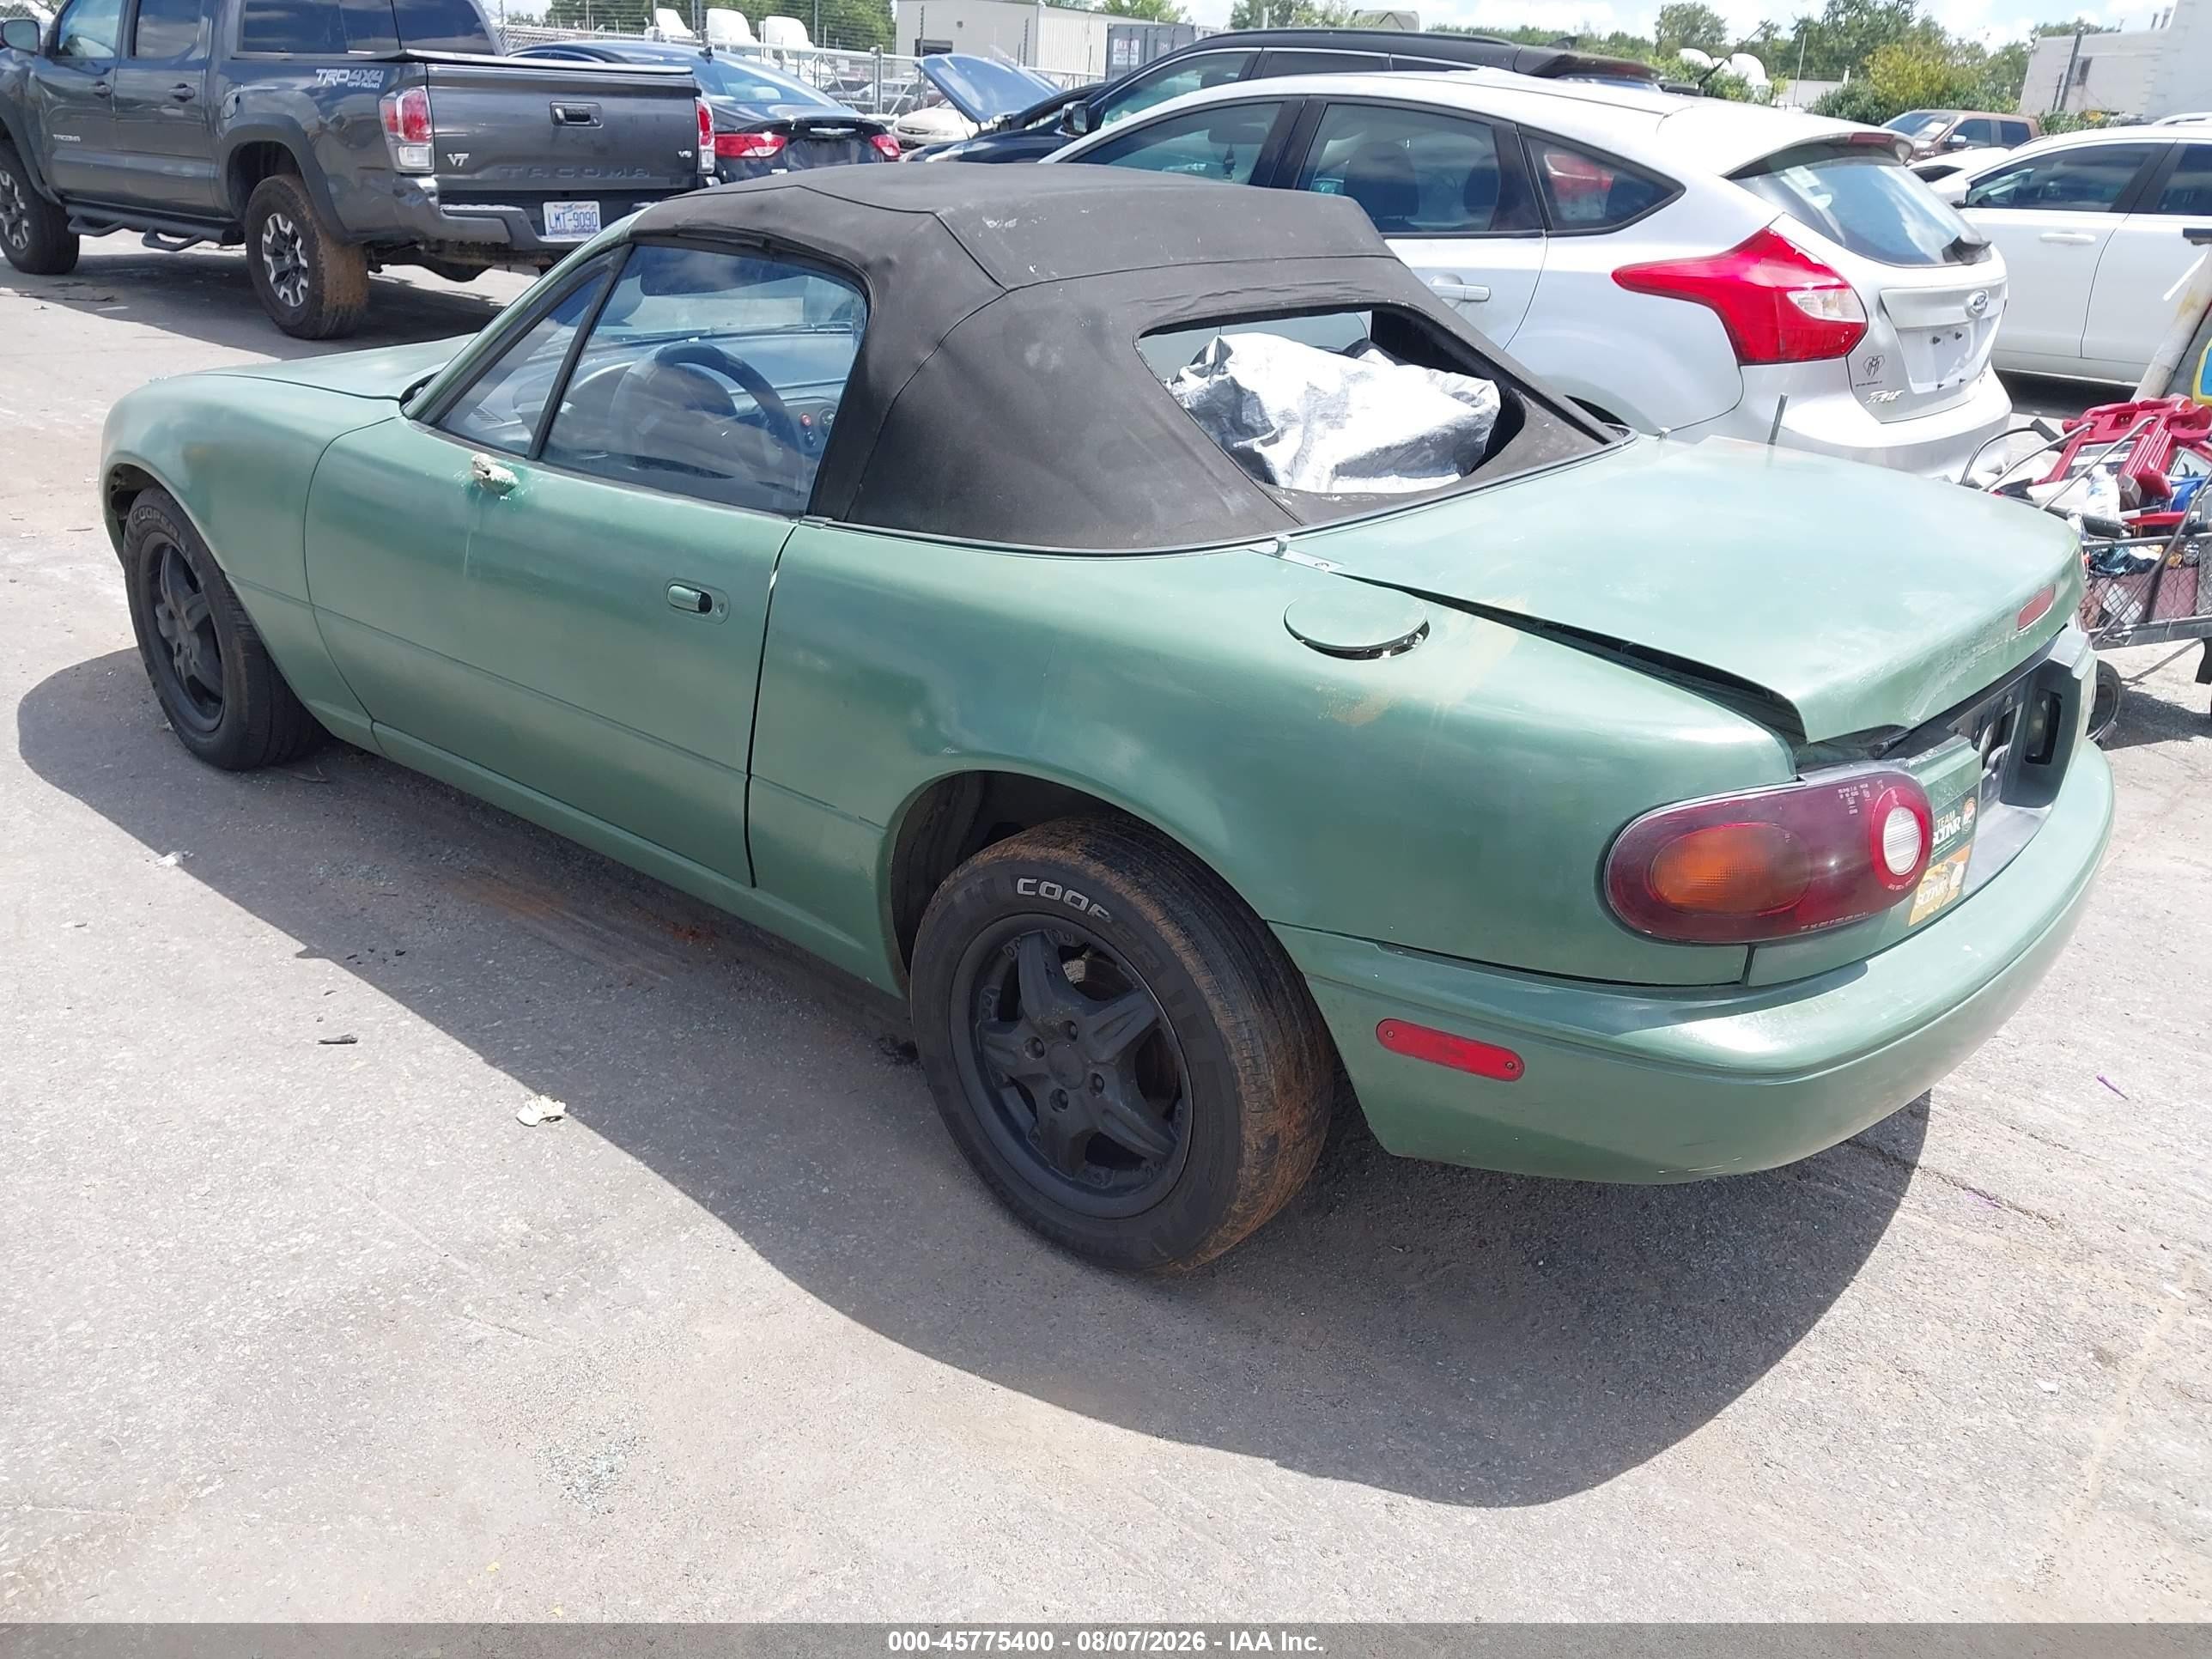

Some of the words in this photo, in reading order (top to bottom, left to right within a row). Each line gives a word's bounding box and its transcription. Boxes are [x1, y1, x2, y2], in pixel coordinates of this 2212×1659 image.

[316, 69, 349, 86] TRD
[447, 153, 470, 167] VT
[500, 167, 650, 179] TACOMA
[549, 211, 599, 228] LMT-9090
[1936, 810, 1955, 827] TEAM
